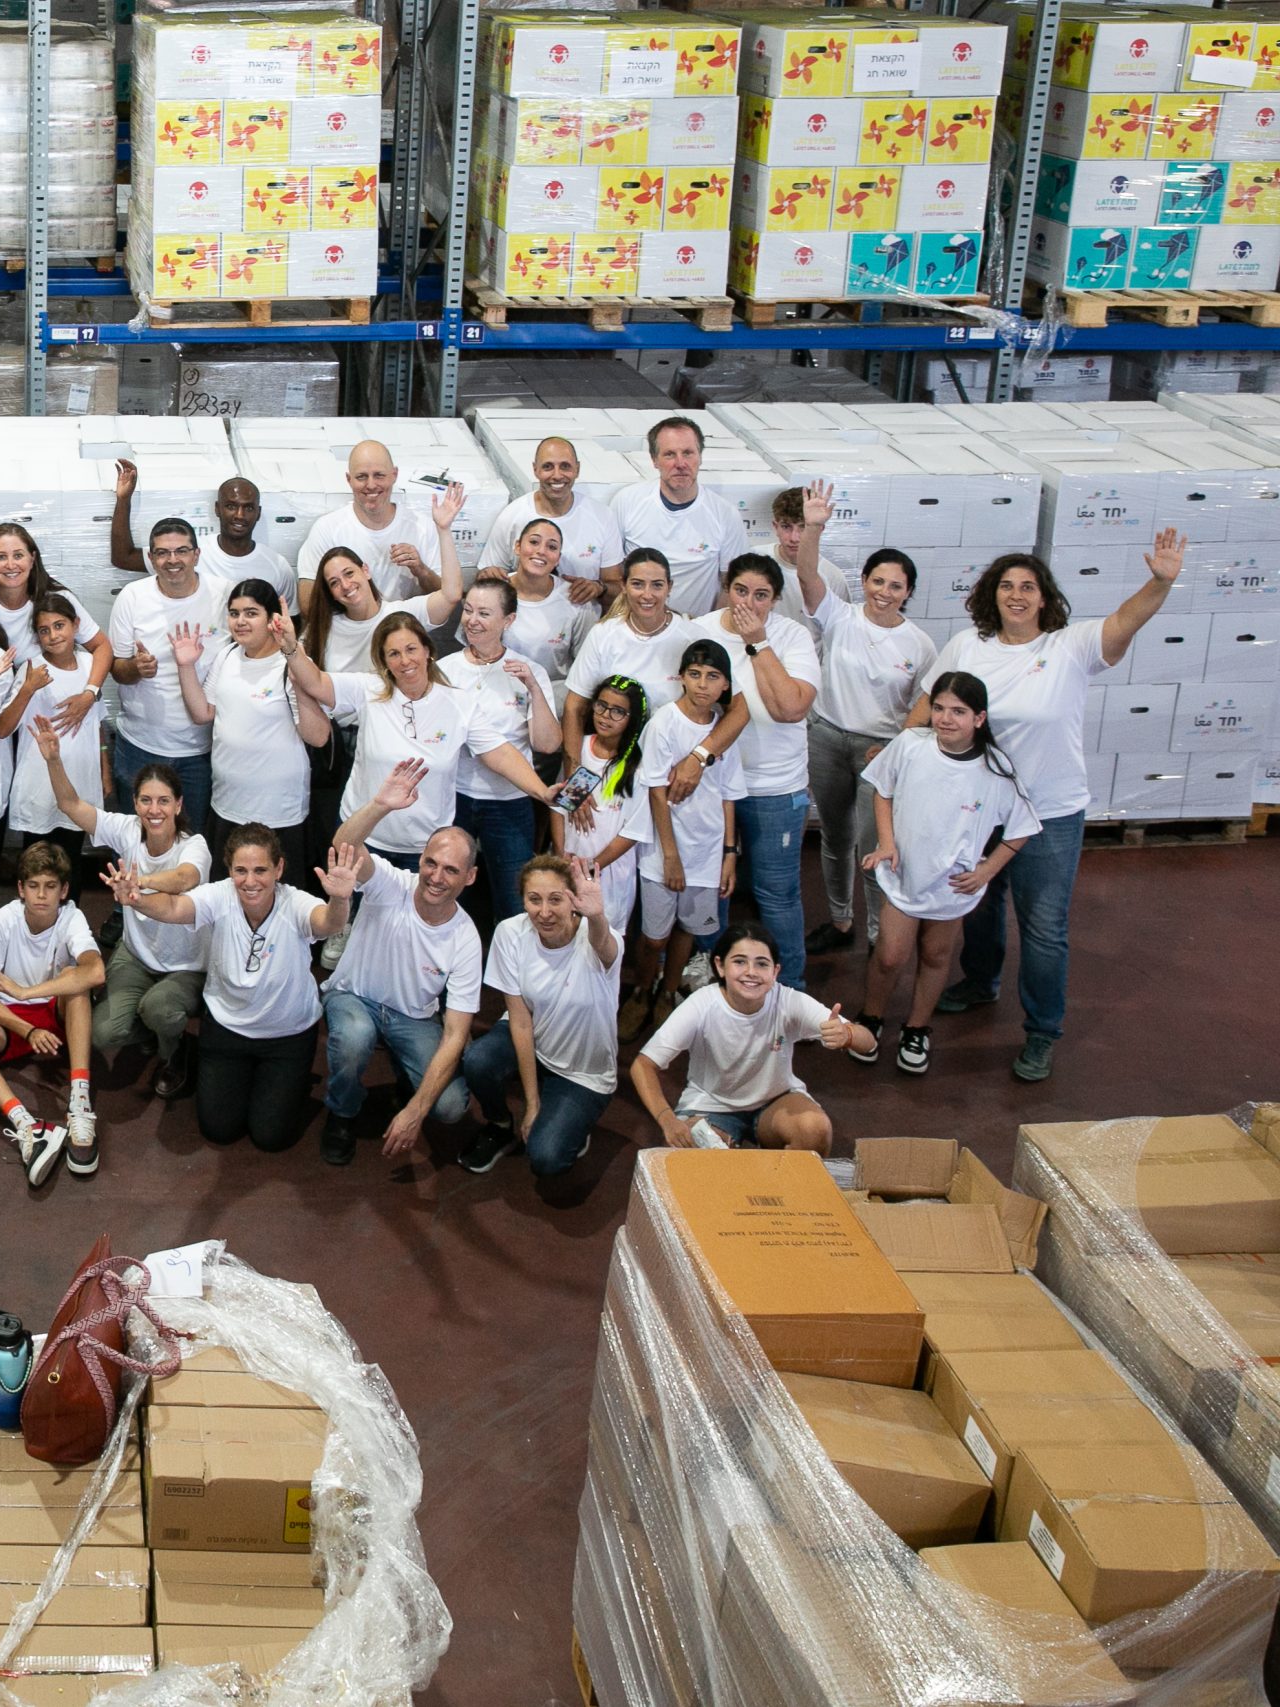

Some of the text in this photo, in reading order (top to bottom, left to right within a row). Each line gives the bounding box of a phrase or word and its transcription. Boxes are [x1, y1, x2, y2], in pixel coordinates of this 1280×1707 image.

[871, 54, 905, 65] הקצאת
[867, 69, 907, 78] שואה חג
[82, 329, 94, 339] 17
[422, 325, 433, 336] 18
[466, 327, 480, 338] 21
[949, 327, 965, 338] 22
[1102, 507, 1126, 518] יחד
[1240, 577, 1265, 587] יחד
[1218, 716, 1242, 727] יחד
